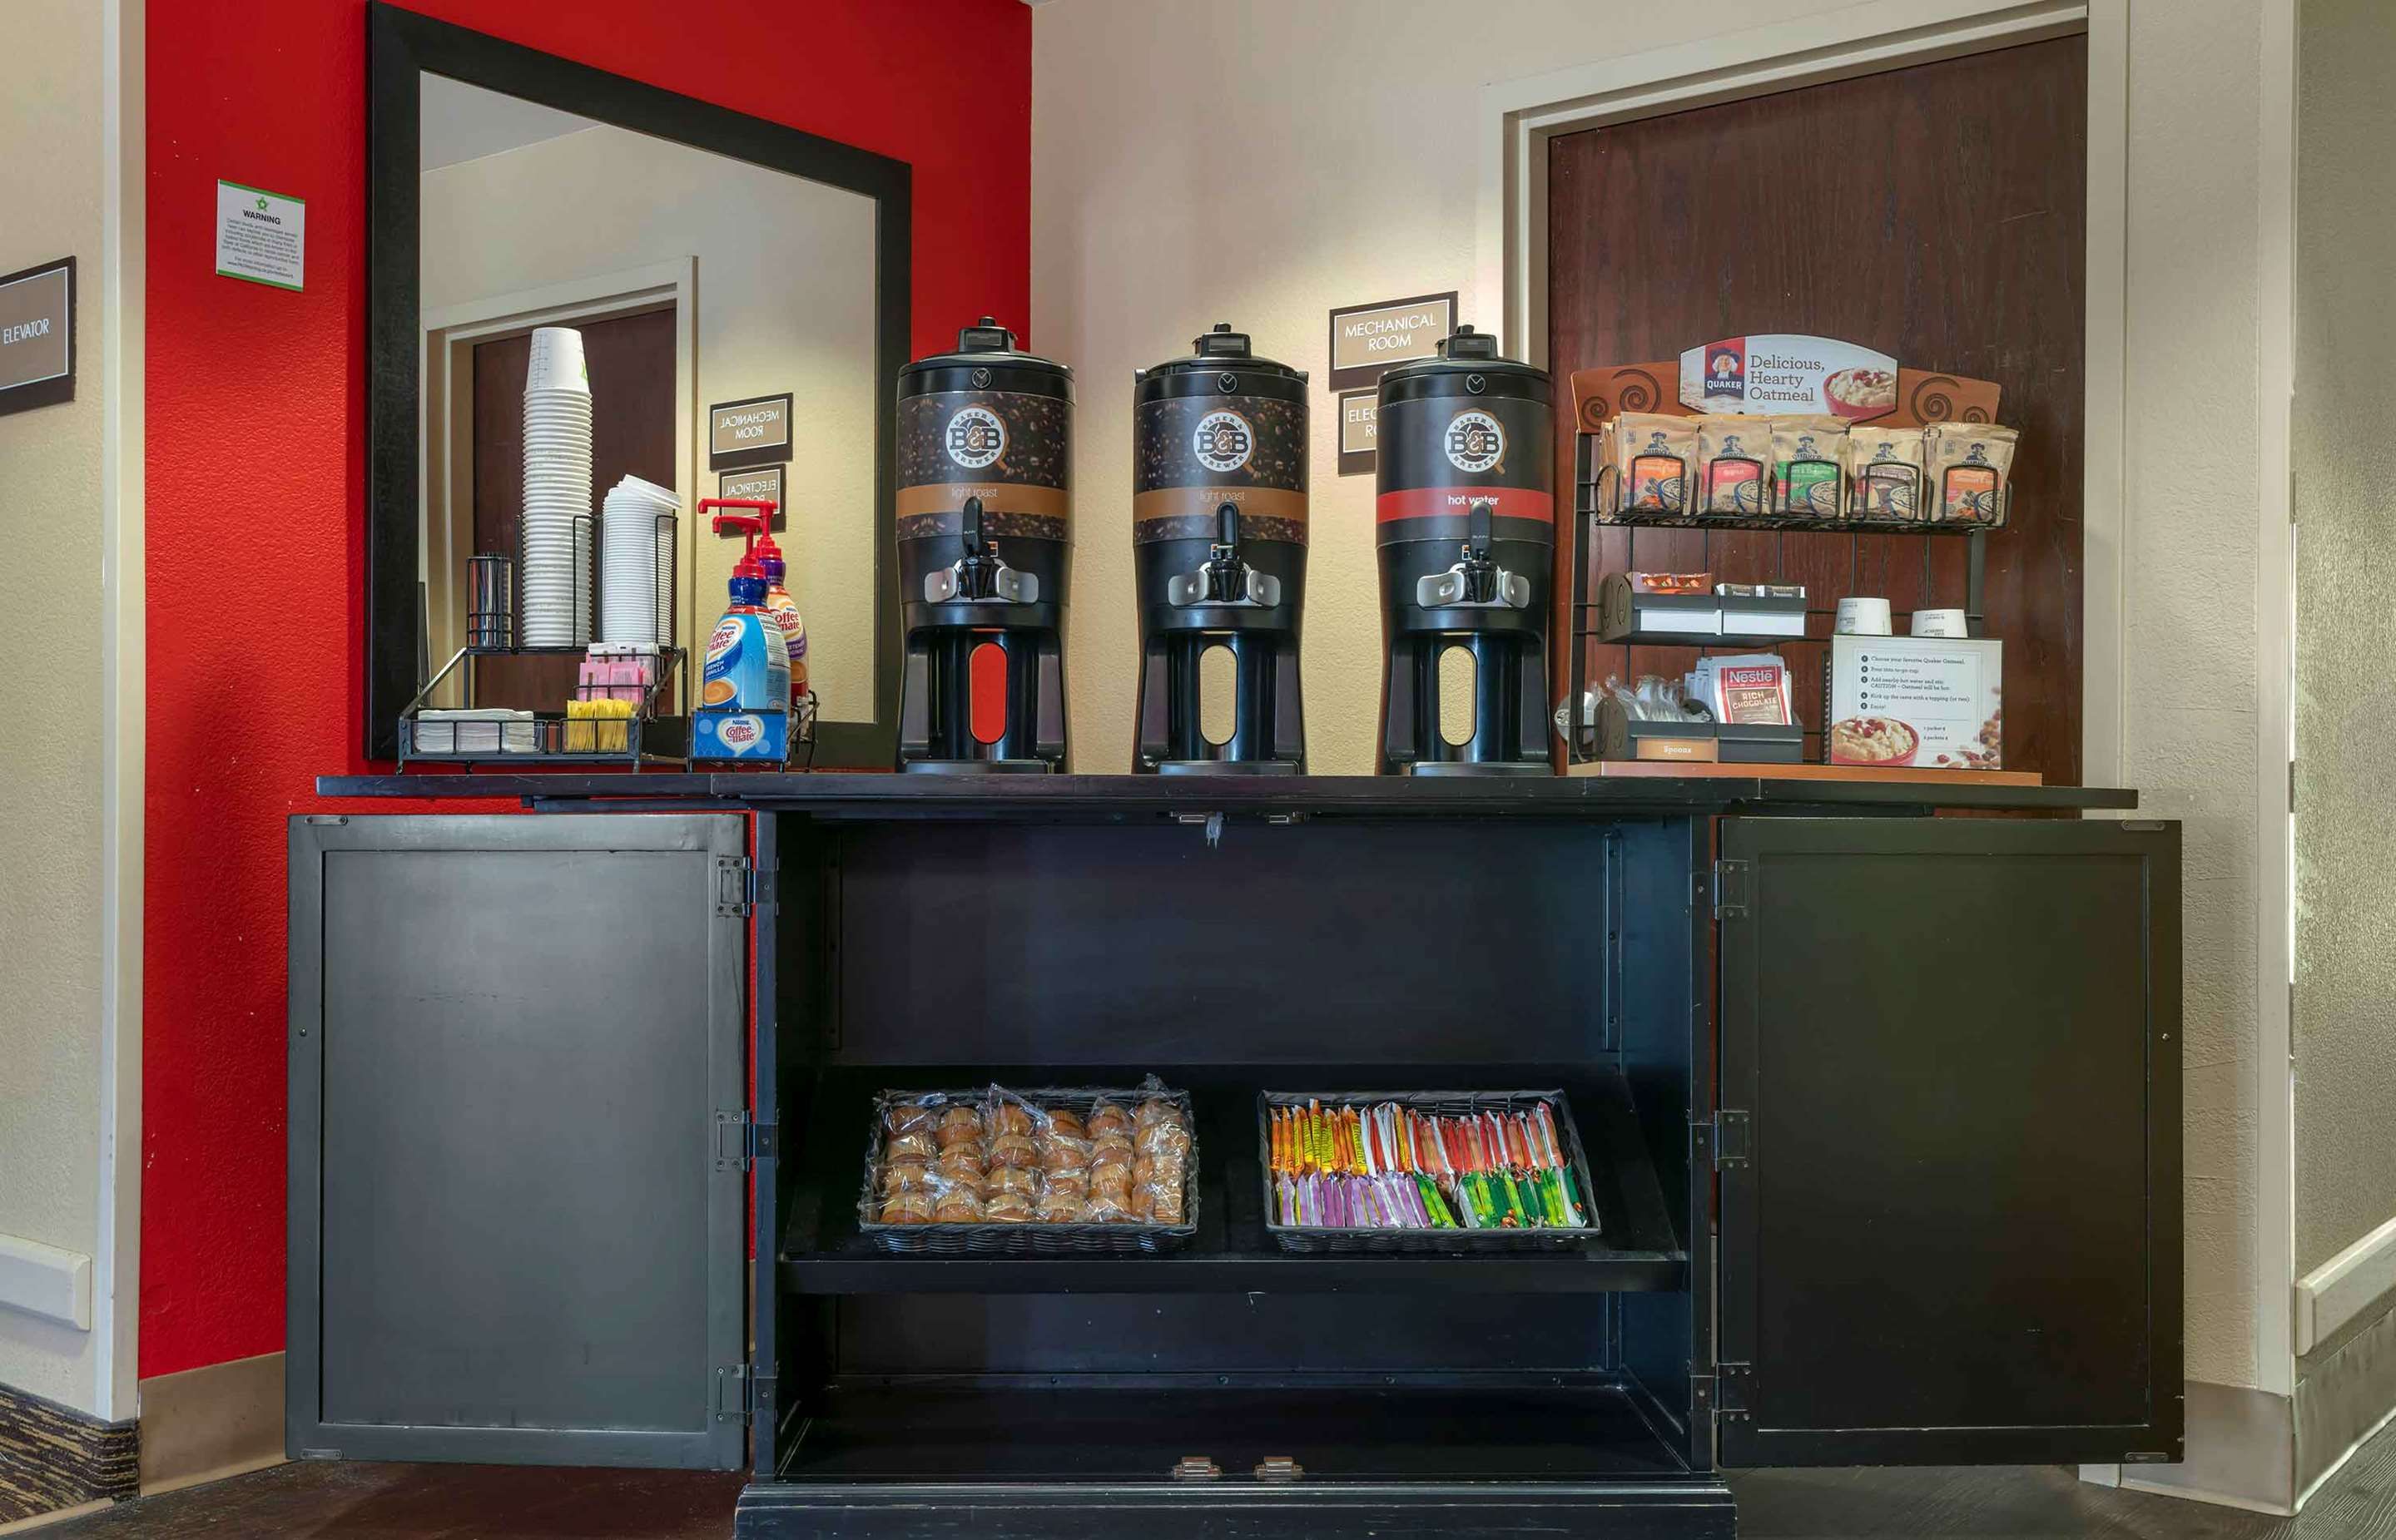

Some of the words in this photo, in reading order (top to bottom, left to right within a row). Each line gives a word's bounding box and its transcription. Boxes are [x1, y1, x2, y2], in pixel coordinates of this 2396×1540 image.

[242, 209, 281, 225] WARNING
[3, 318, 50, 344] ELEVATOR
[1345, 312, 1437, 338] MECHANICAL
[1368, 334, 1412, 352] ROOM
[1750, 354, 1825, 371] Delicious,
[1706, 379, 1742, 389] QUAKER
[1750, 371, 1804, 389] Hearty
[1749, 386, 1814, 402] Oatmeal
[949, 426, 1001, 450] B&B
[1198, 430, 1248, 453] B&B
[1448, 431, 1500, 454] B&B
[1221, 492, 1246, 501] roast
[1448, 494, 1466, 505] hot
[775, 612, 799, 624] offee
[1730, 669, 1773, 683] Nestlé
[1732, 697, 1778, 710] CHOCOLATE
[1742, 691, 1764, 701] RICH
[726, 725, 752, 738] Coffee
[732, 732, 755, 743] mate
[1664, 745, 1692, 755] Spoons
